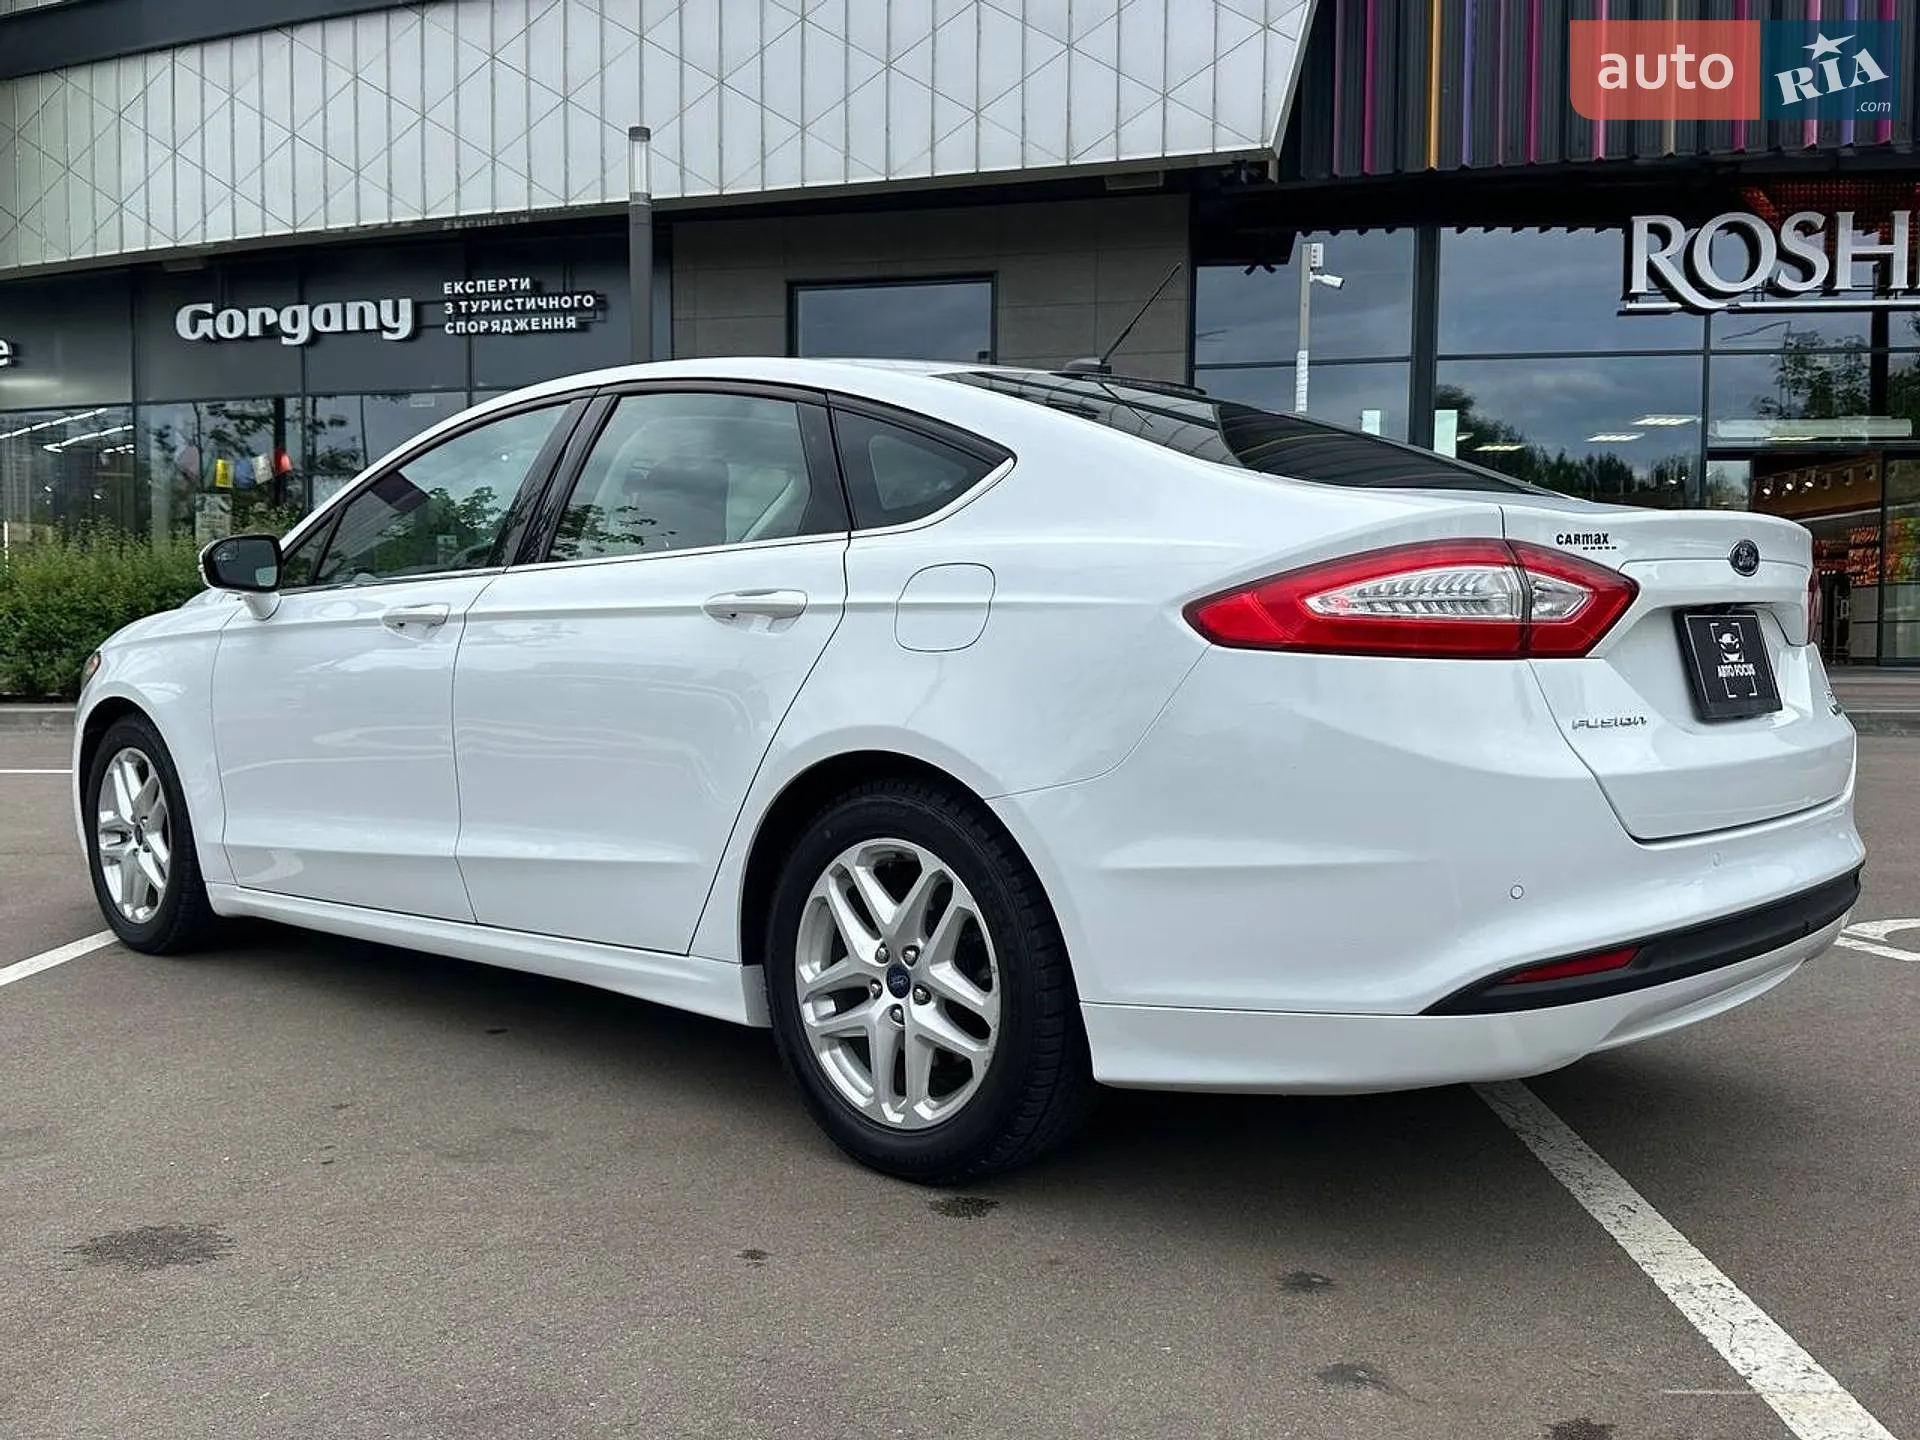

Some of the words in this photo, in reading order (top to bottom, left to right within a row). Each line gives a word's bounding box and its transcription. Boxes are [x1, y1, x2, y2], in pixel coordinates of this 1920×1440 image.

[1629, 211, 1920, 309] ROSH
[443, 277, 531, 294] ЕКСПЕРТИ
[458, 295, 595, 314] ТУРИСТИЧНОГО
[175, 298, 413, 345] Gorgany
[444, 316, 577, 334] СПОРЯДЖЕННЯ
